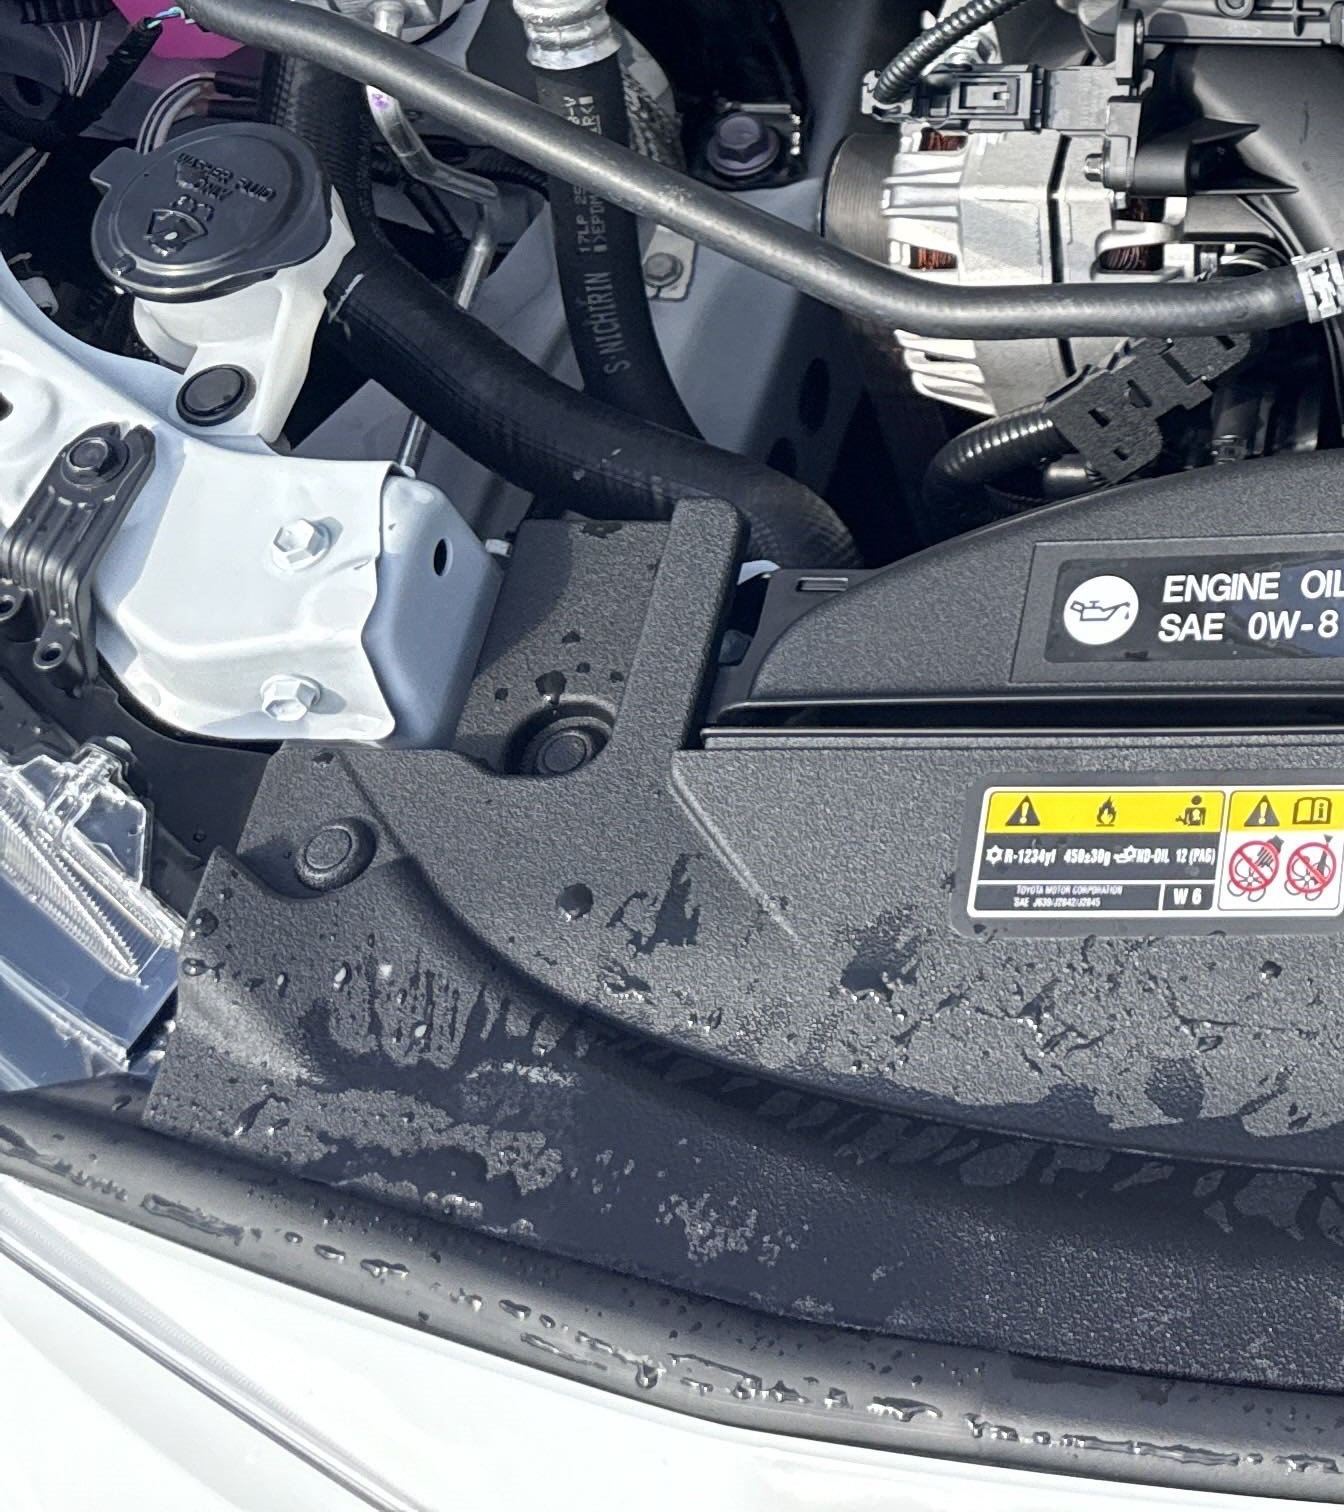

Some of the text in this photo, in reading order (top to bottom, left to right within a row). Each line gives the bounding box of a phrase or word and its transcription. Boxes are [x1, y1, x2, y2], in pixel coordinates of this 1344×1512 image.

[1162, 570, 1281, 605] ENGINE
[1157, 609, 1340, 643] SAE 0W-8
[1003, 847, 1057, 867] R-1234yf
[1175, 847, 1188, 864] 12
[1188, 847, 1217, 866] (PAG)
[1016, 884, 1123, 896] TOYOTA MOTOR CORPORATION
[1191, 888, 1203, 905] 6
[1013, 896, 1030, 908] SAE
